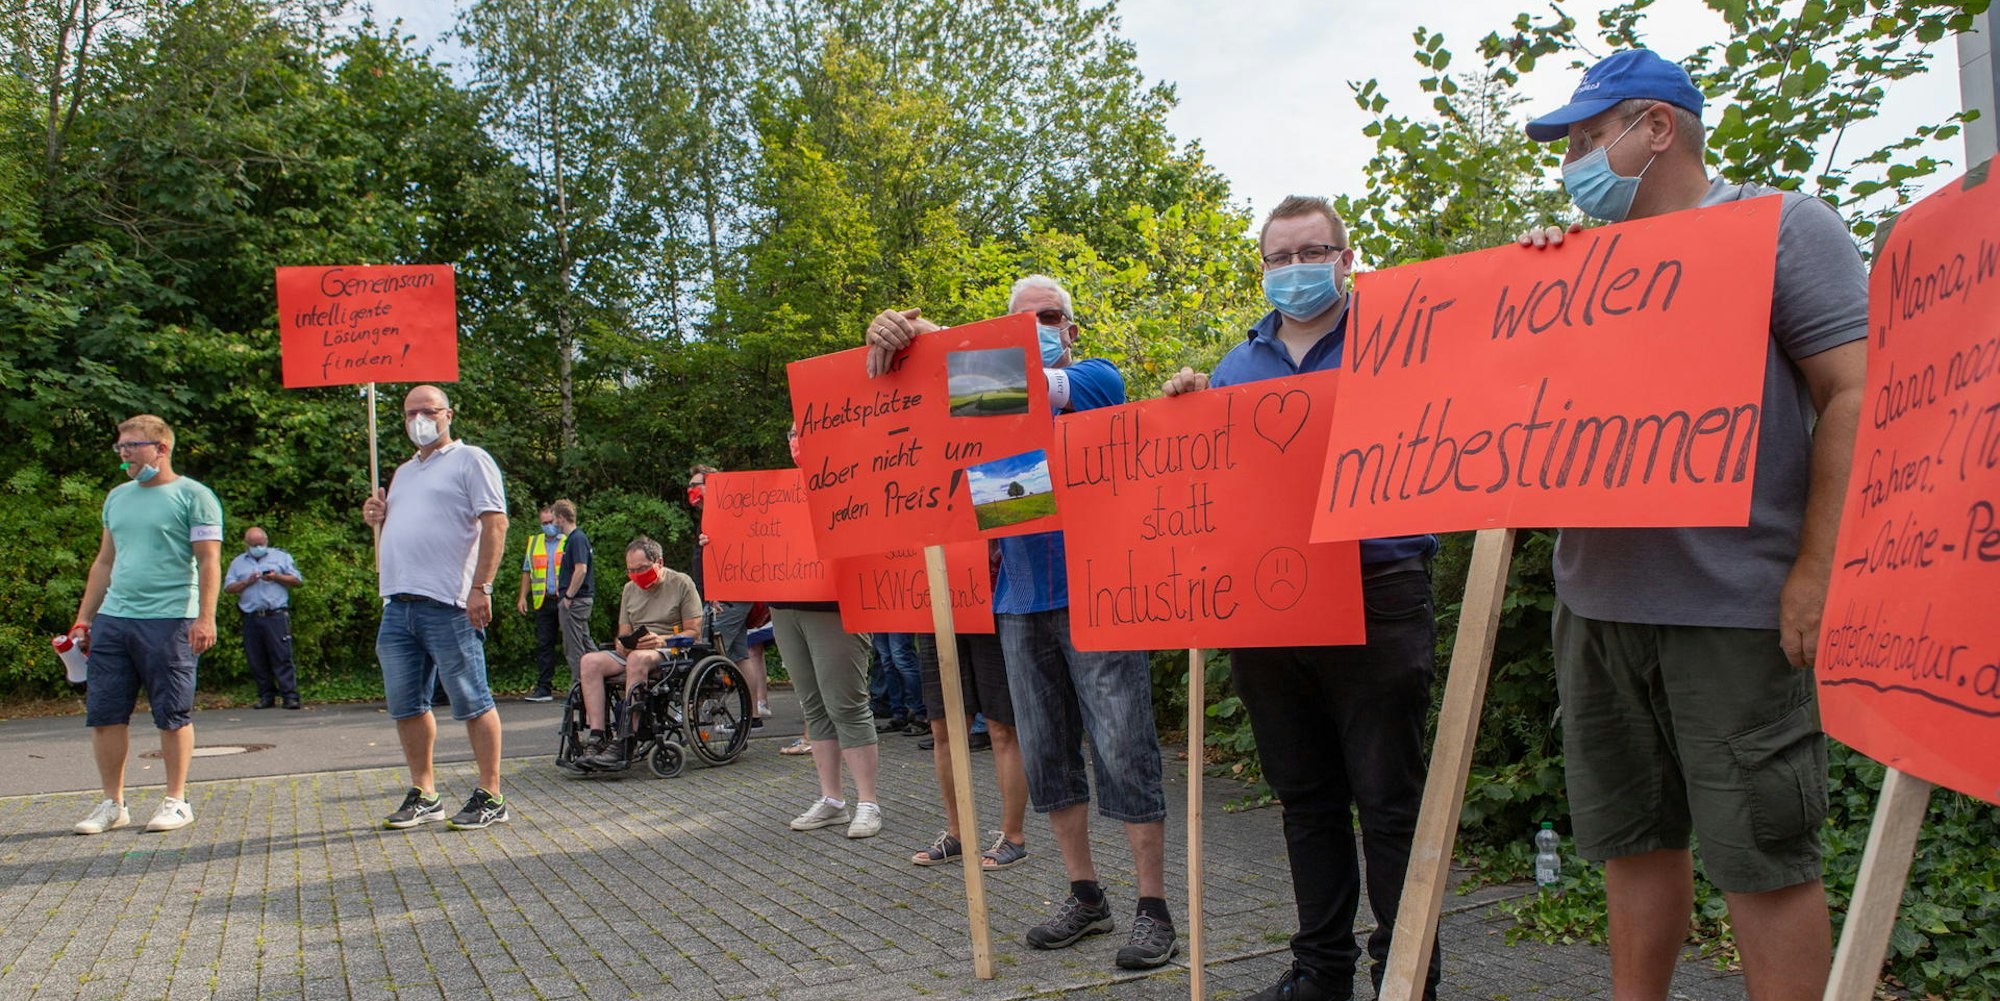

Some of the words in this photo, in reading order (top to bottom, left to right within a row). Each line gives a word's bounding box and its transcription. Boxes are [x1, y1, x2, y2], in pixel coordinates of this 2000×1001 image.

[321, 268, 435, 297] Gemeinsam
[1352, 279, 1456, 376] Wir
[1491, 233, 1682, 340] wollen
[295, 300, 393, 328] intelligente
[323, 326, 400, 347] Lösungen
[800, 389, 923, 438] Arbeitsplätze
[1875, 361, 1937, 430] dann
[808, 456, 859, 491] aber
[872, 438, 923, 472] nicht
[945, 440, 982, 461] um
[1062, 393, 1237, 496] Luftkurort
[1329, 378, 1759, 513] mitbestimmen
[828, 496, 869, 530] jeden
[884, 468, 964, 518] Preis!
[1141, 482, 1217, 540] statt
[749, 518, 782, 537] statt
[711, 543, 824, 583] Verkehrslärm
[858, 567, 986, 610] LKW-Geank
[1086, 547, 1240, 627] Industrie
